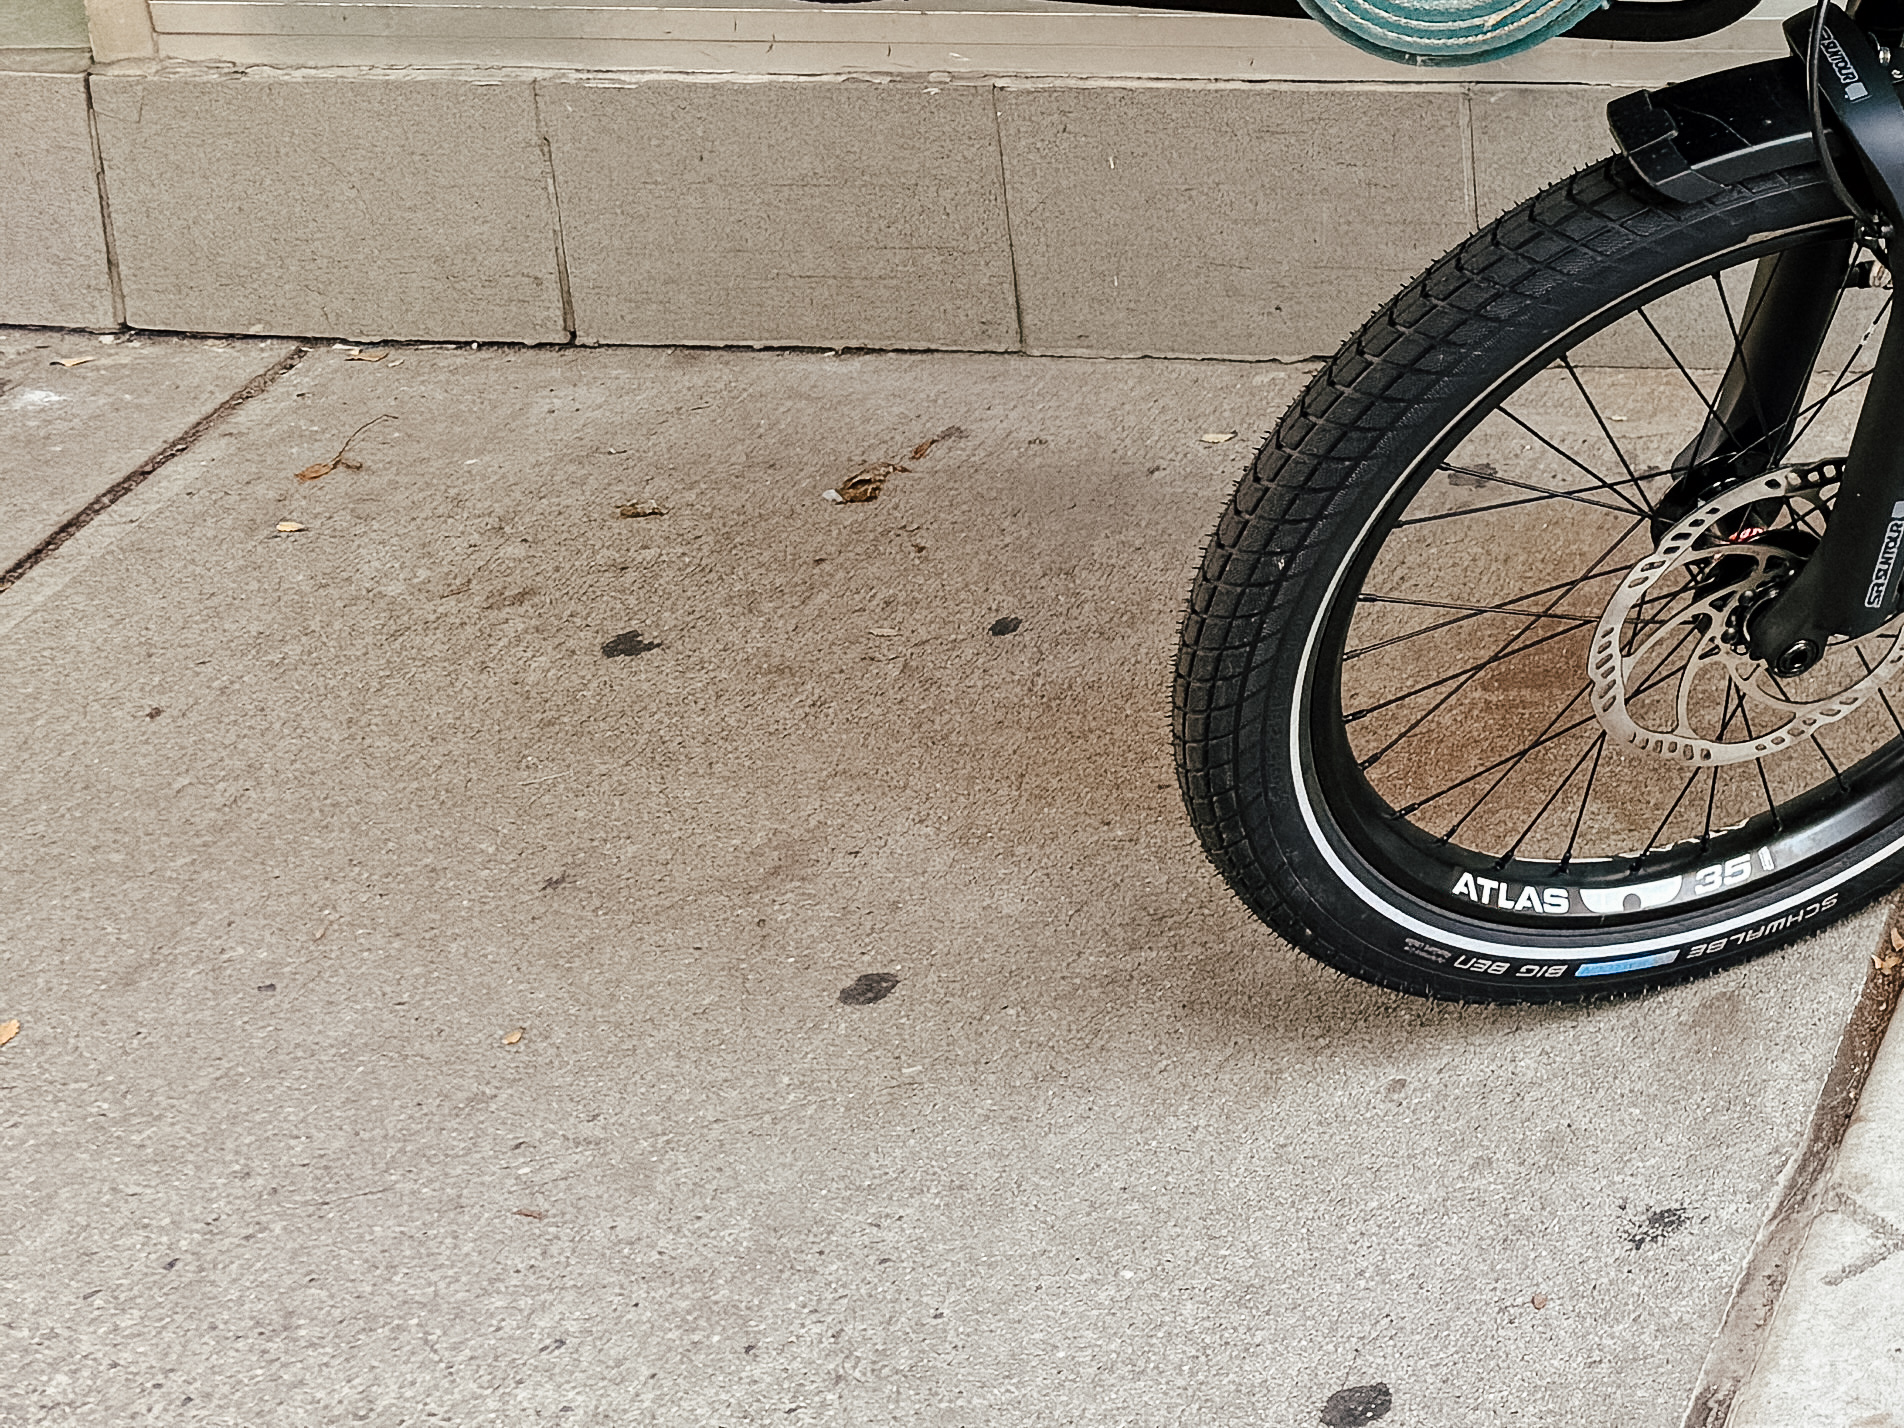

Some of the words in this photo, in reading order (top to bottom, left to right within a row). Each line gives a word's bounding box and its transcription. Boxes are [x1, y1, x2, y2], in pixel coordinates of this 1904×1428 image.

[1452, 871, 1570, 915] ATLAS
[1687, 892, 1839, 960] SCHWALBE
[1453, 956, 1512, 977] BEN
[1514, 963, 1568, 978] BIG
